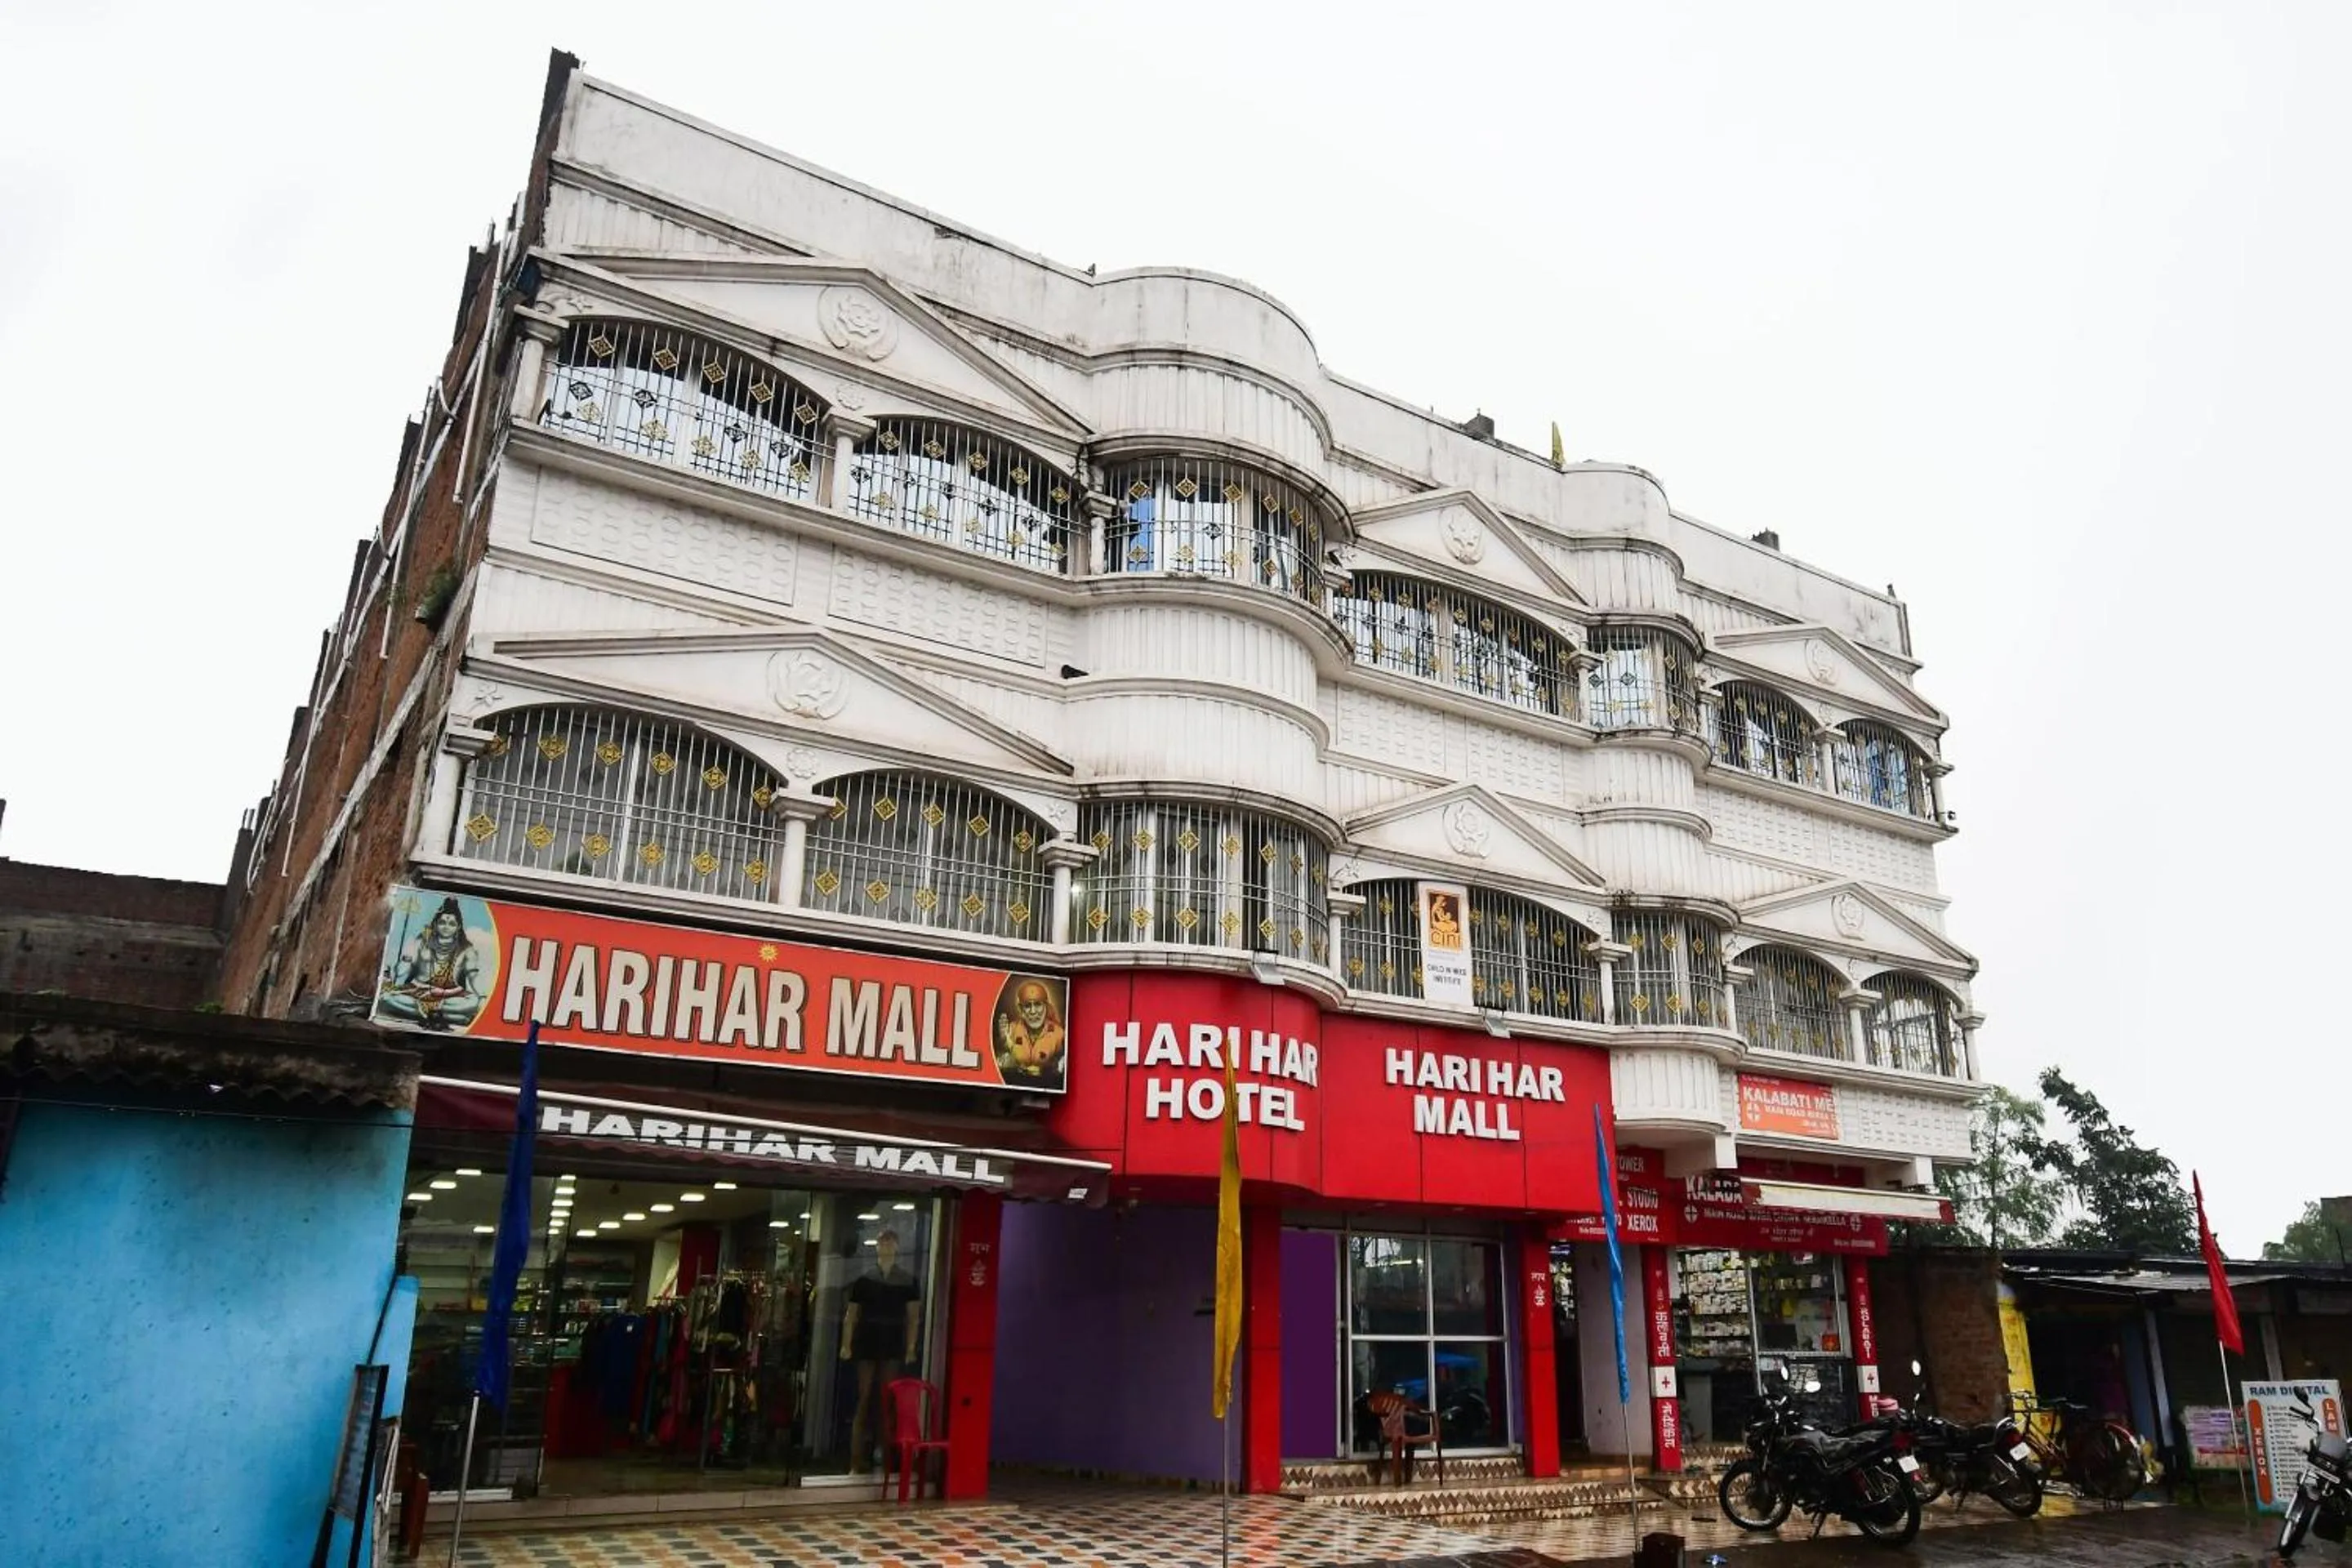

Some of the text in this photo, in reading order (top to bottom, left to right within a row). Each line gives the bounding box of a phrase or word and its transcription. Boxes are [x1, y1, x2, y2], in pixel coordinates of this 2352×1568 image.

[502, 935, 982, 1070] HARIHAR MALL
[1145, 1077, 1305, 1132] HOTEL
[1413, 1094, 1521, 1141] MALL
[1743, 1086, 1811, 1108] KALABATI
[541, 1106, 1005, 1183] HARIHAR MALL
[1627, 1187, 1659, 1209] STUDIO
[1627, 1214, 1659, 1233] XEROX
[2249, 1385, 2329, 1396] RAM DITAL
[2254, 1427, 2267, 1476] XEROX
